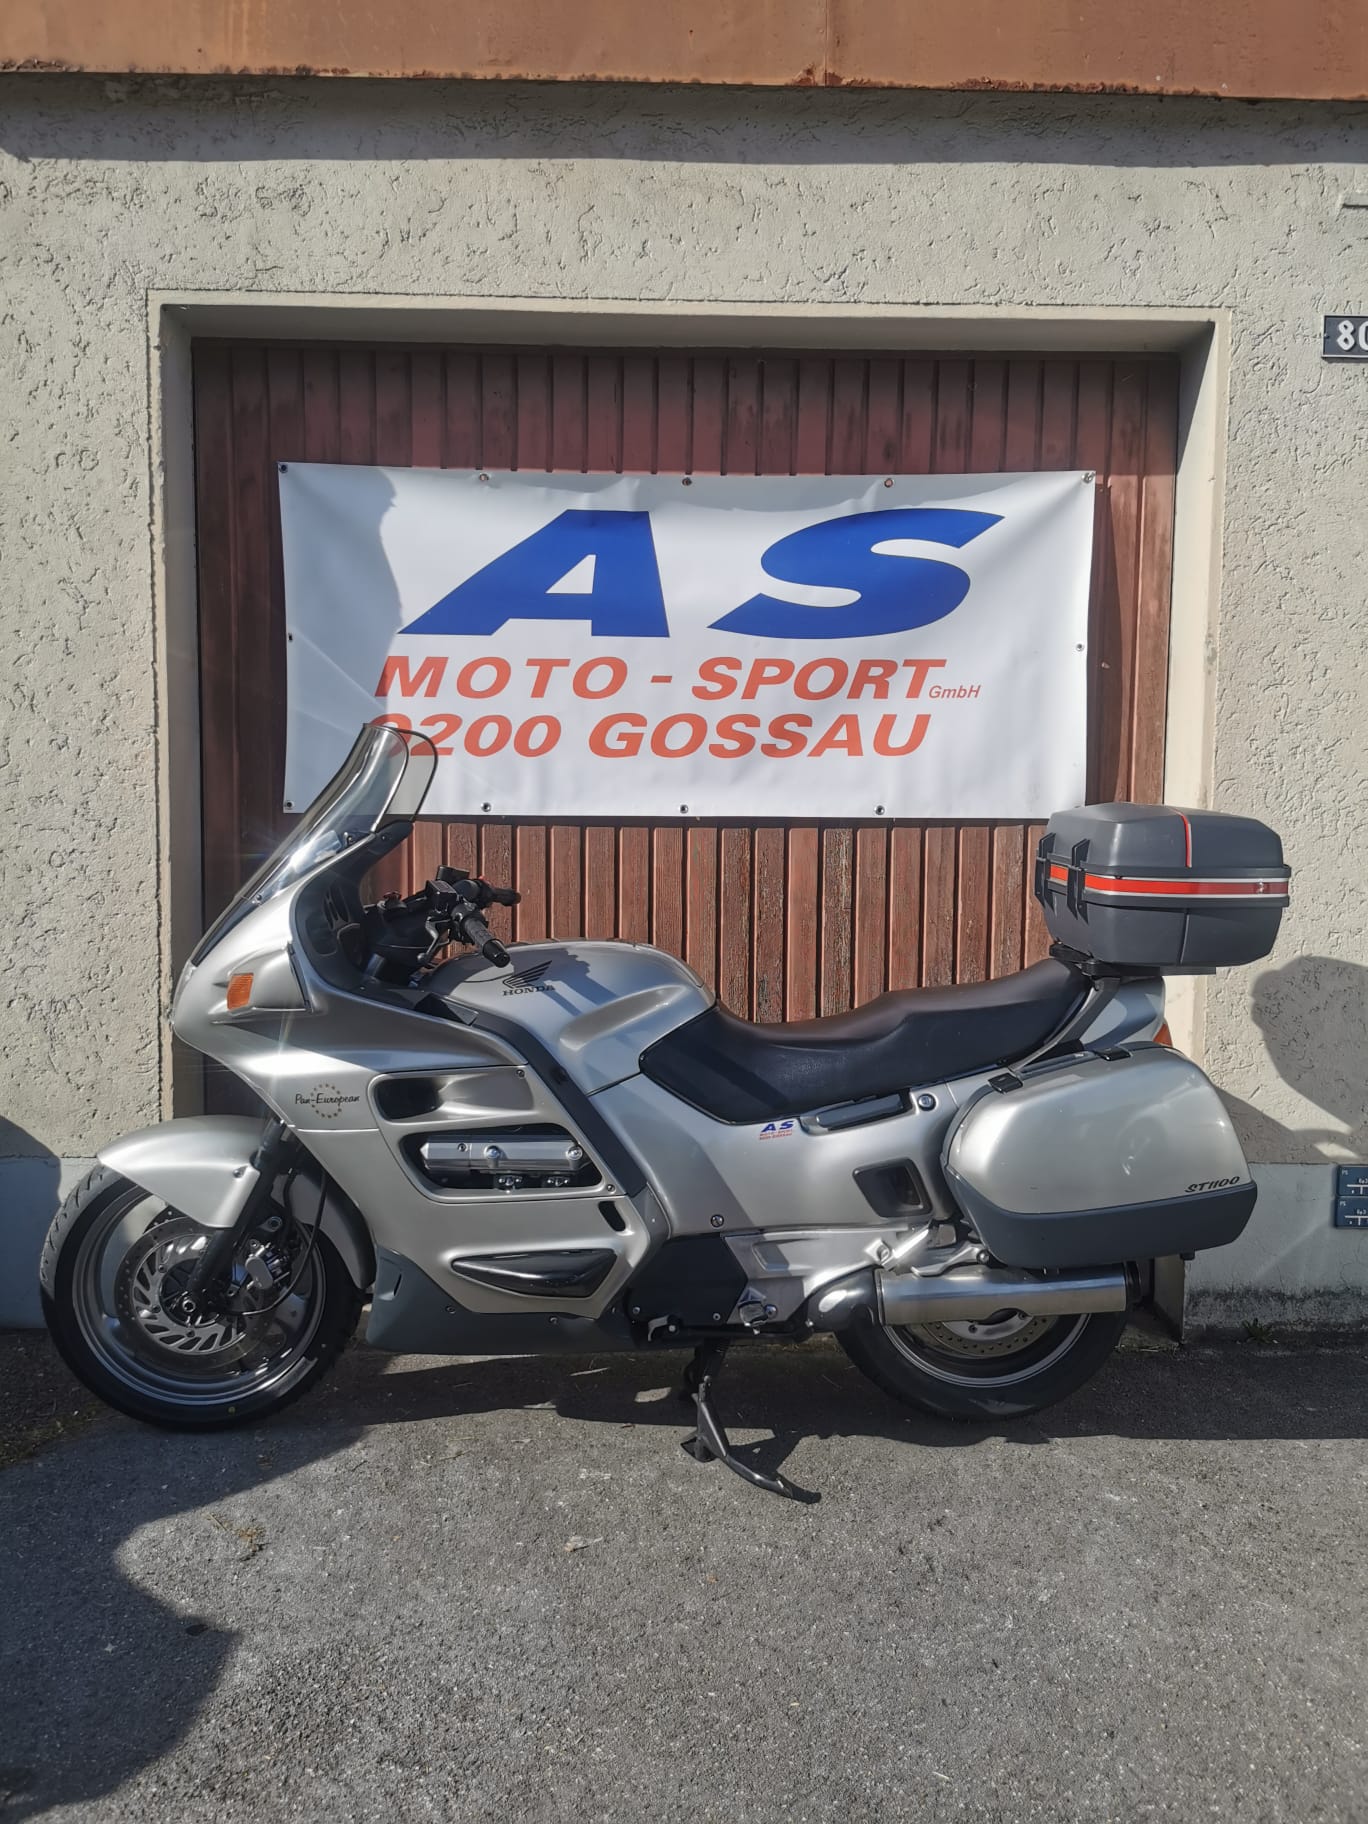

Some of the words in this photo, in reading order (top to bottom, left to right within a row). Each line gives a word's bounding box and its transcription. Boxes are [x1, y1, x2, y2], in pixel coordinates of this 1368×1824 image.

[374, 655, 628, 700] MOTO
[691, 656, 947, 701] SPORT
[928, 685, 981, 699] GmbH
[588, 712, 931, 759] GOSSAU
[503, 985, 556, 996] HONDA
[1184, 1176, 1240, 1193] ST1100
